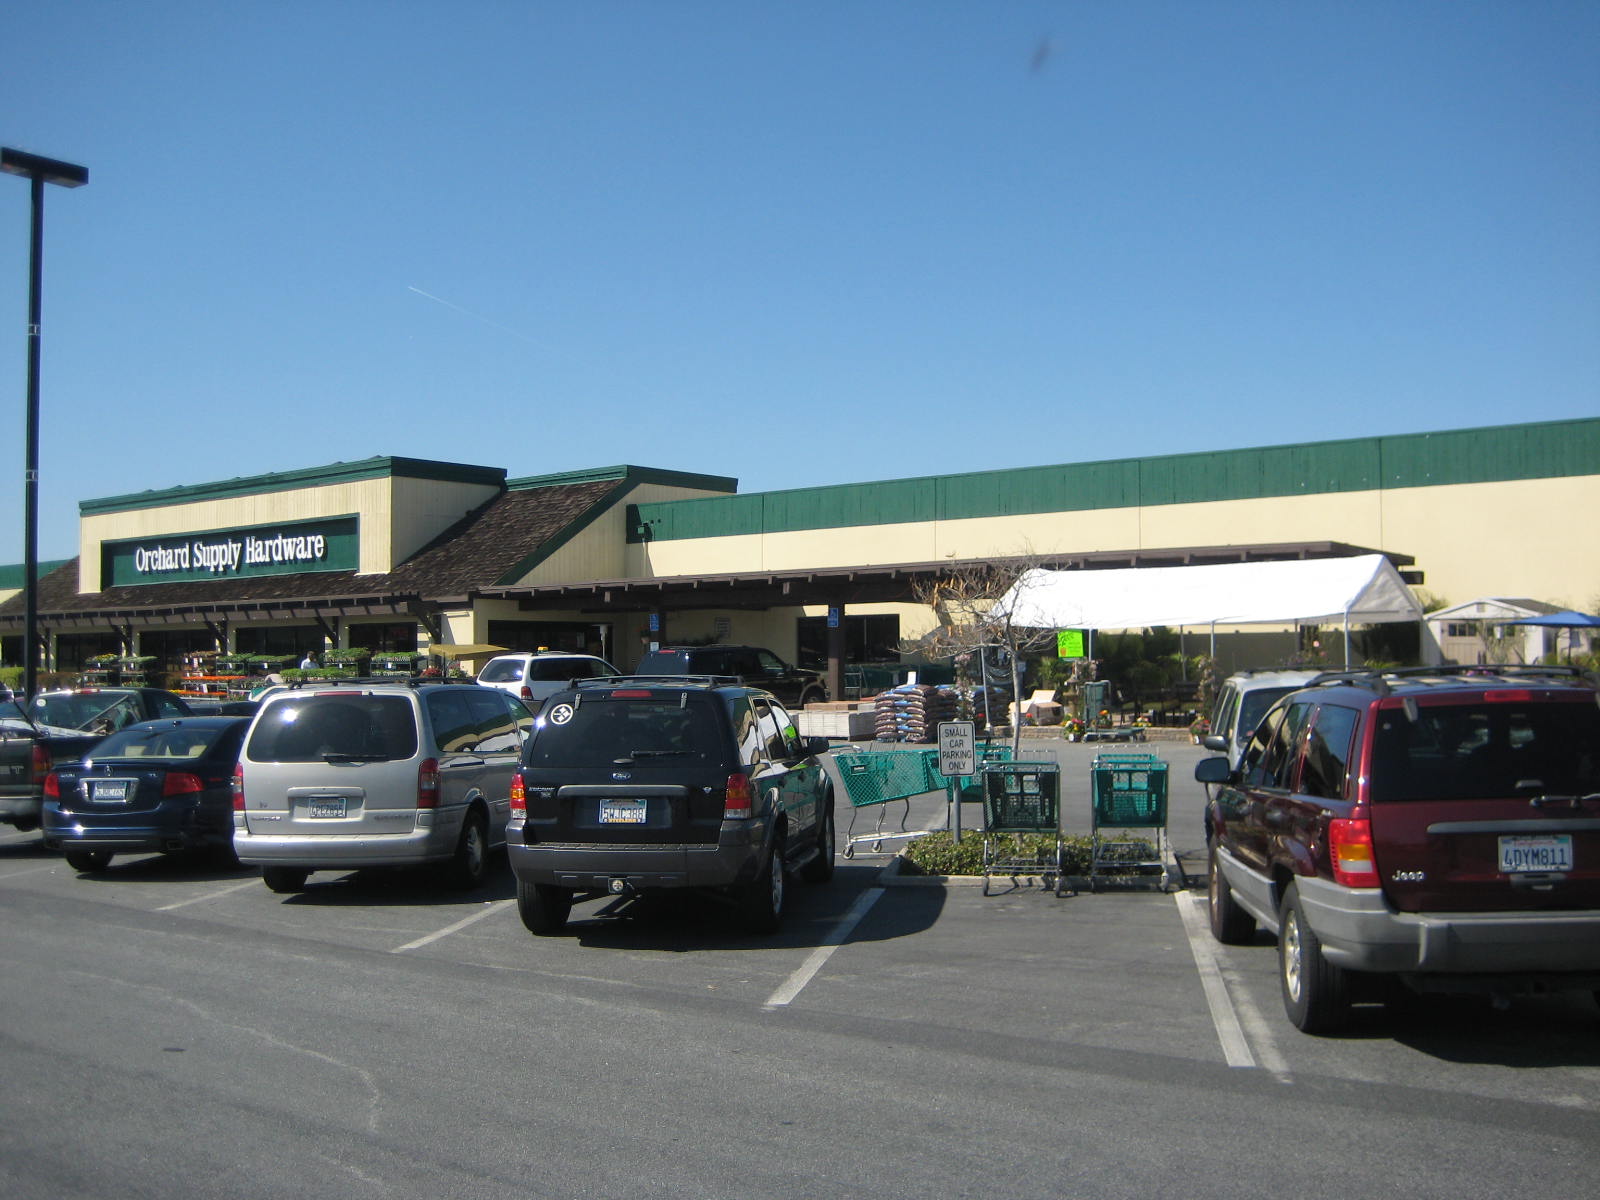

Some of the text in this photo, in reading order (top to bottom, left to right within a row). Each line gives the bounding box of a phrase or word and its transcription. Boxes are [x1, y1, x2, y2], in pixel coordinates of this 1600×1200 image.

[135, 533, 324, 572] Orchard Supply Hardware
[944, 728, 968, 738] SMALL
[949, 739, 964, 748] CAR
[942, 750, 973, 760] PARKING
[948, 761, 966, 771] ONLY
[1504, 847, 1567, 866] 4DYM811
[1391, 869, 1425, 882] Jeep
